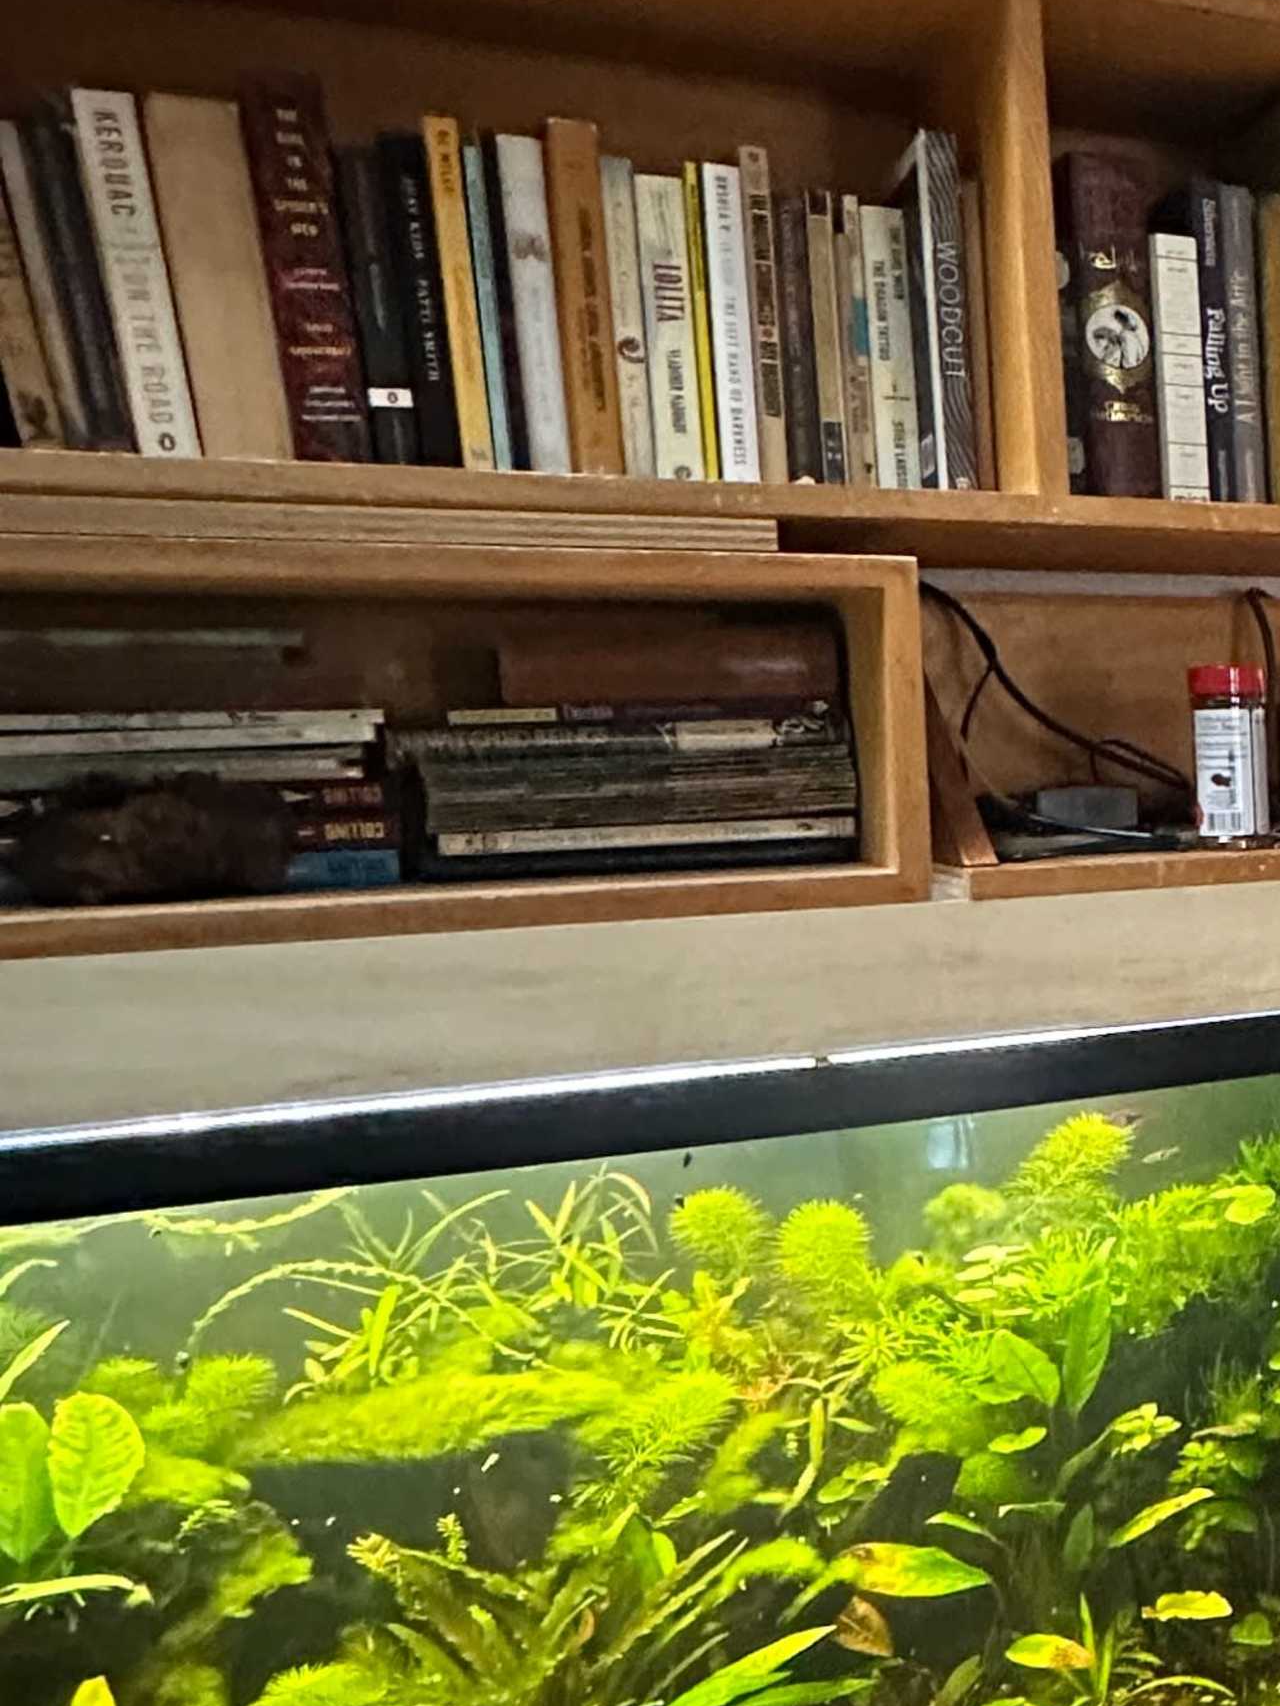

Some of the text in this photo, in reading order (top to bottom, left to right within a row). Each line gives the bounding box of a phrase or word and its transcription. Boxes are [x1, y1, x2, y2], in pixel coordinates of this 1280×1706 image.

[92, 107, 138, 219] KEROUAC
[651, 261, 686, 323] LOLITA
[873, 281, 889, 323] DRAGON
[931, 240, 969, 379] WOODCUT
[121, 271, 176, 427] ON THE ROAD
[422, 330, 441, 382] SMITH
[1198, 306, 1231, 415] Falling Up
[728, 407, 749, 466] DARKNESS
